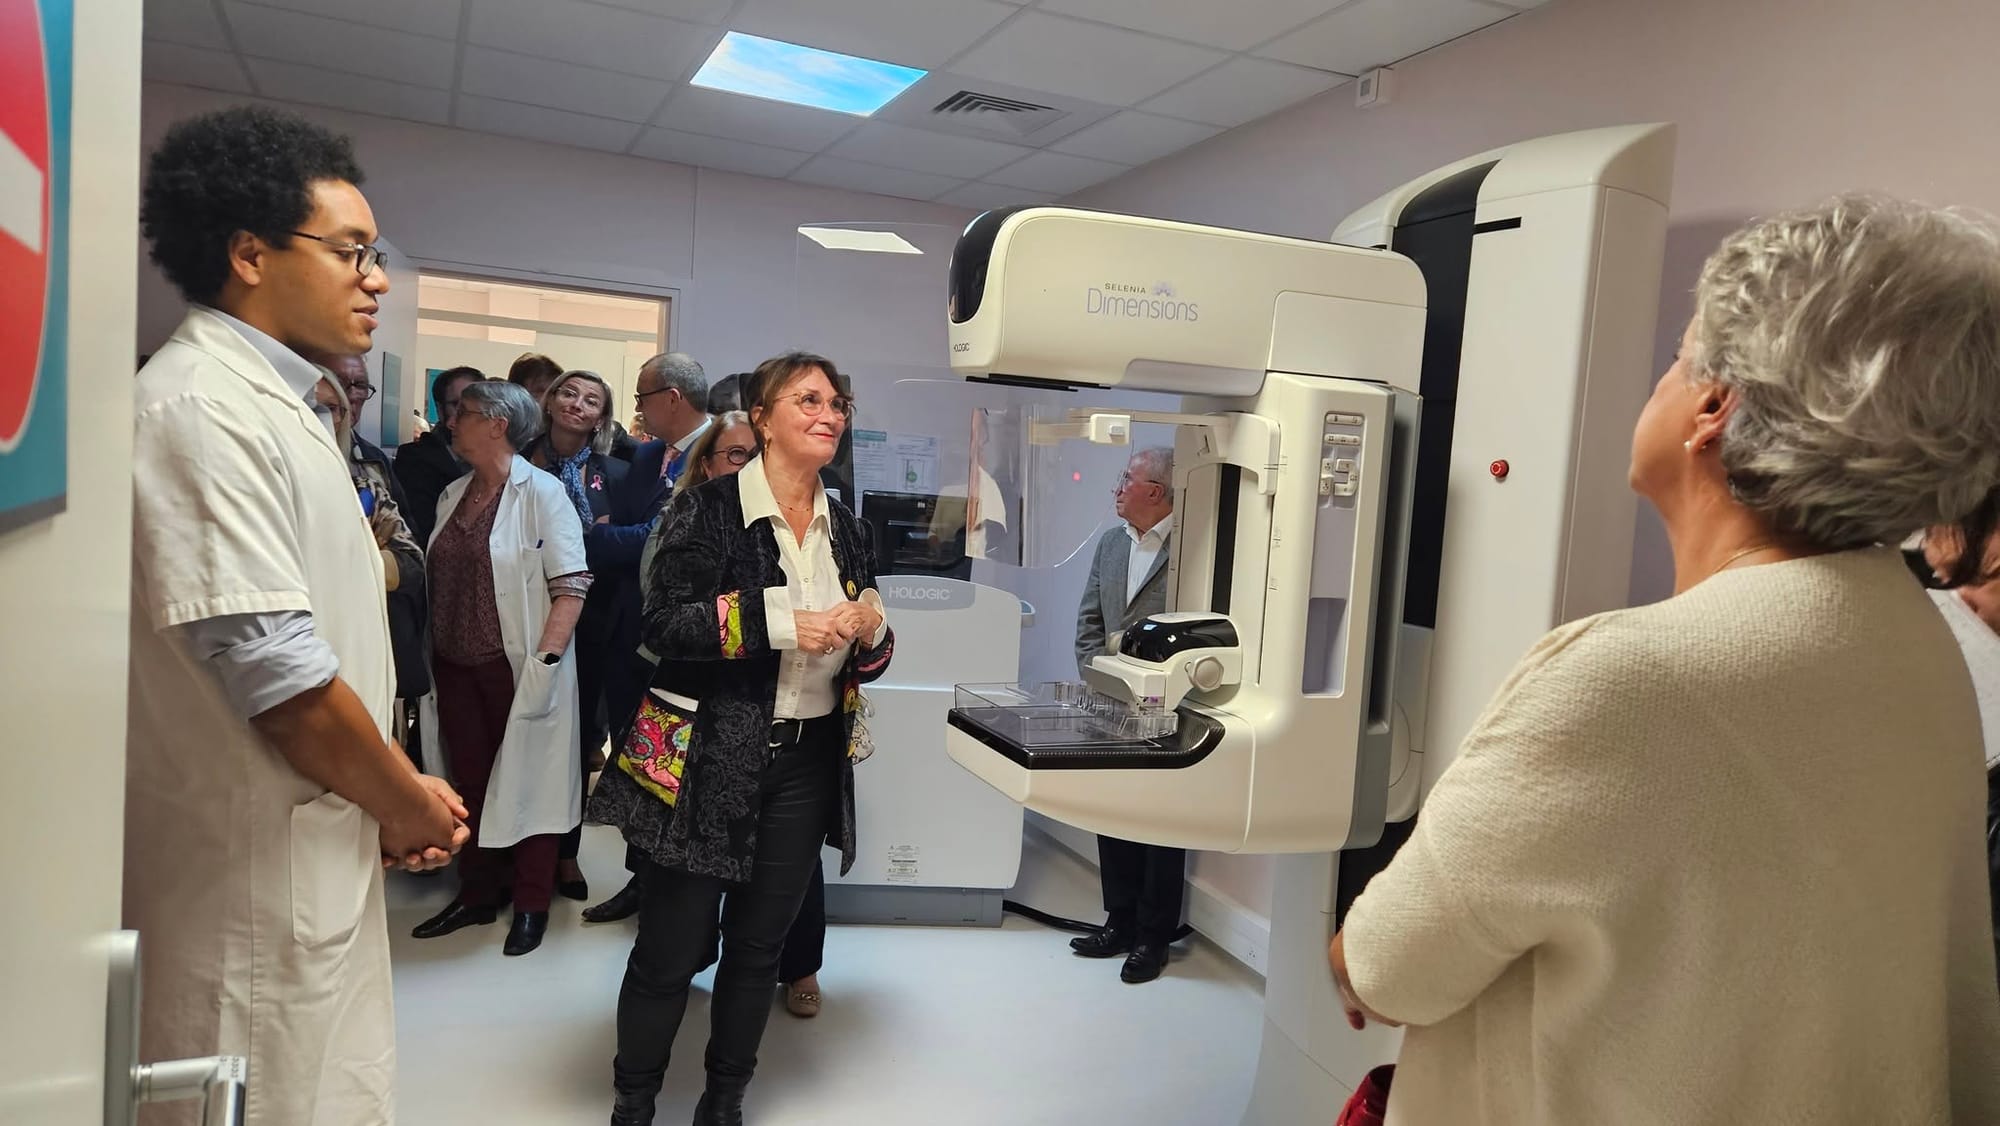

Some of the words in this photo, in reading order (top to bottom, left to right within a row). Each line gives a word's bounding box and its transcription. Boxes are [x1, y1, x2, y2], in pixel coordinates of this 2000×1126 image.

[1104, 282, 1147, 295] SELENIA
[1087, 287, 1199, 322] Dimensions
[888, 585, 951, 601] HOLOGIC
